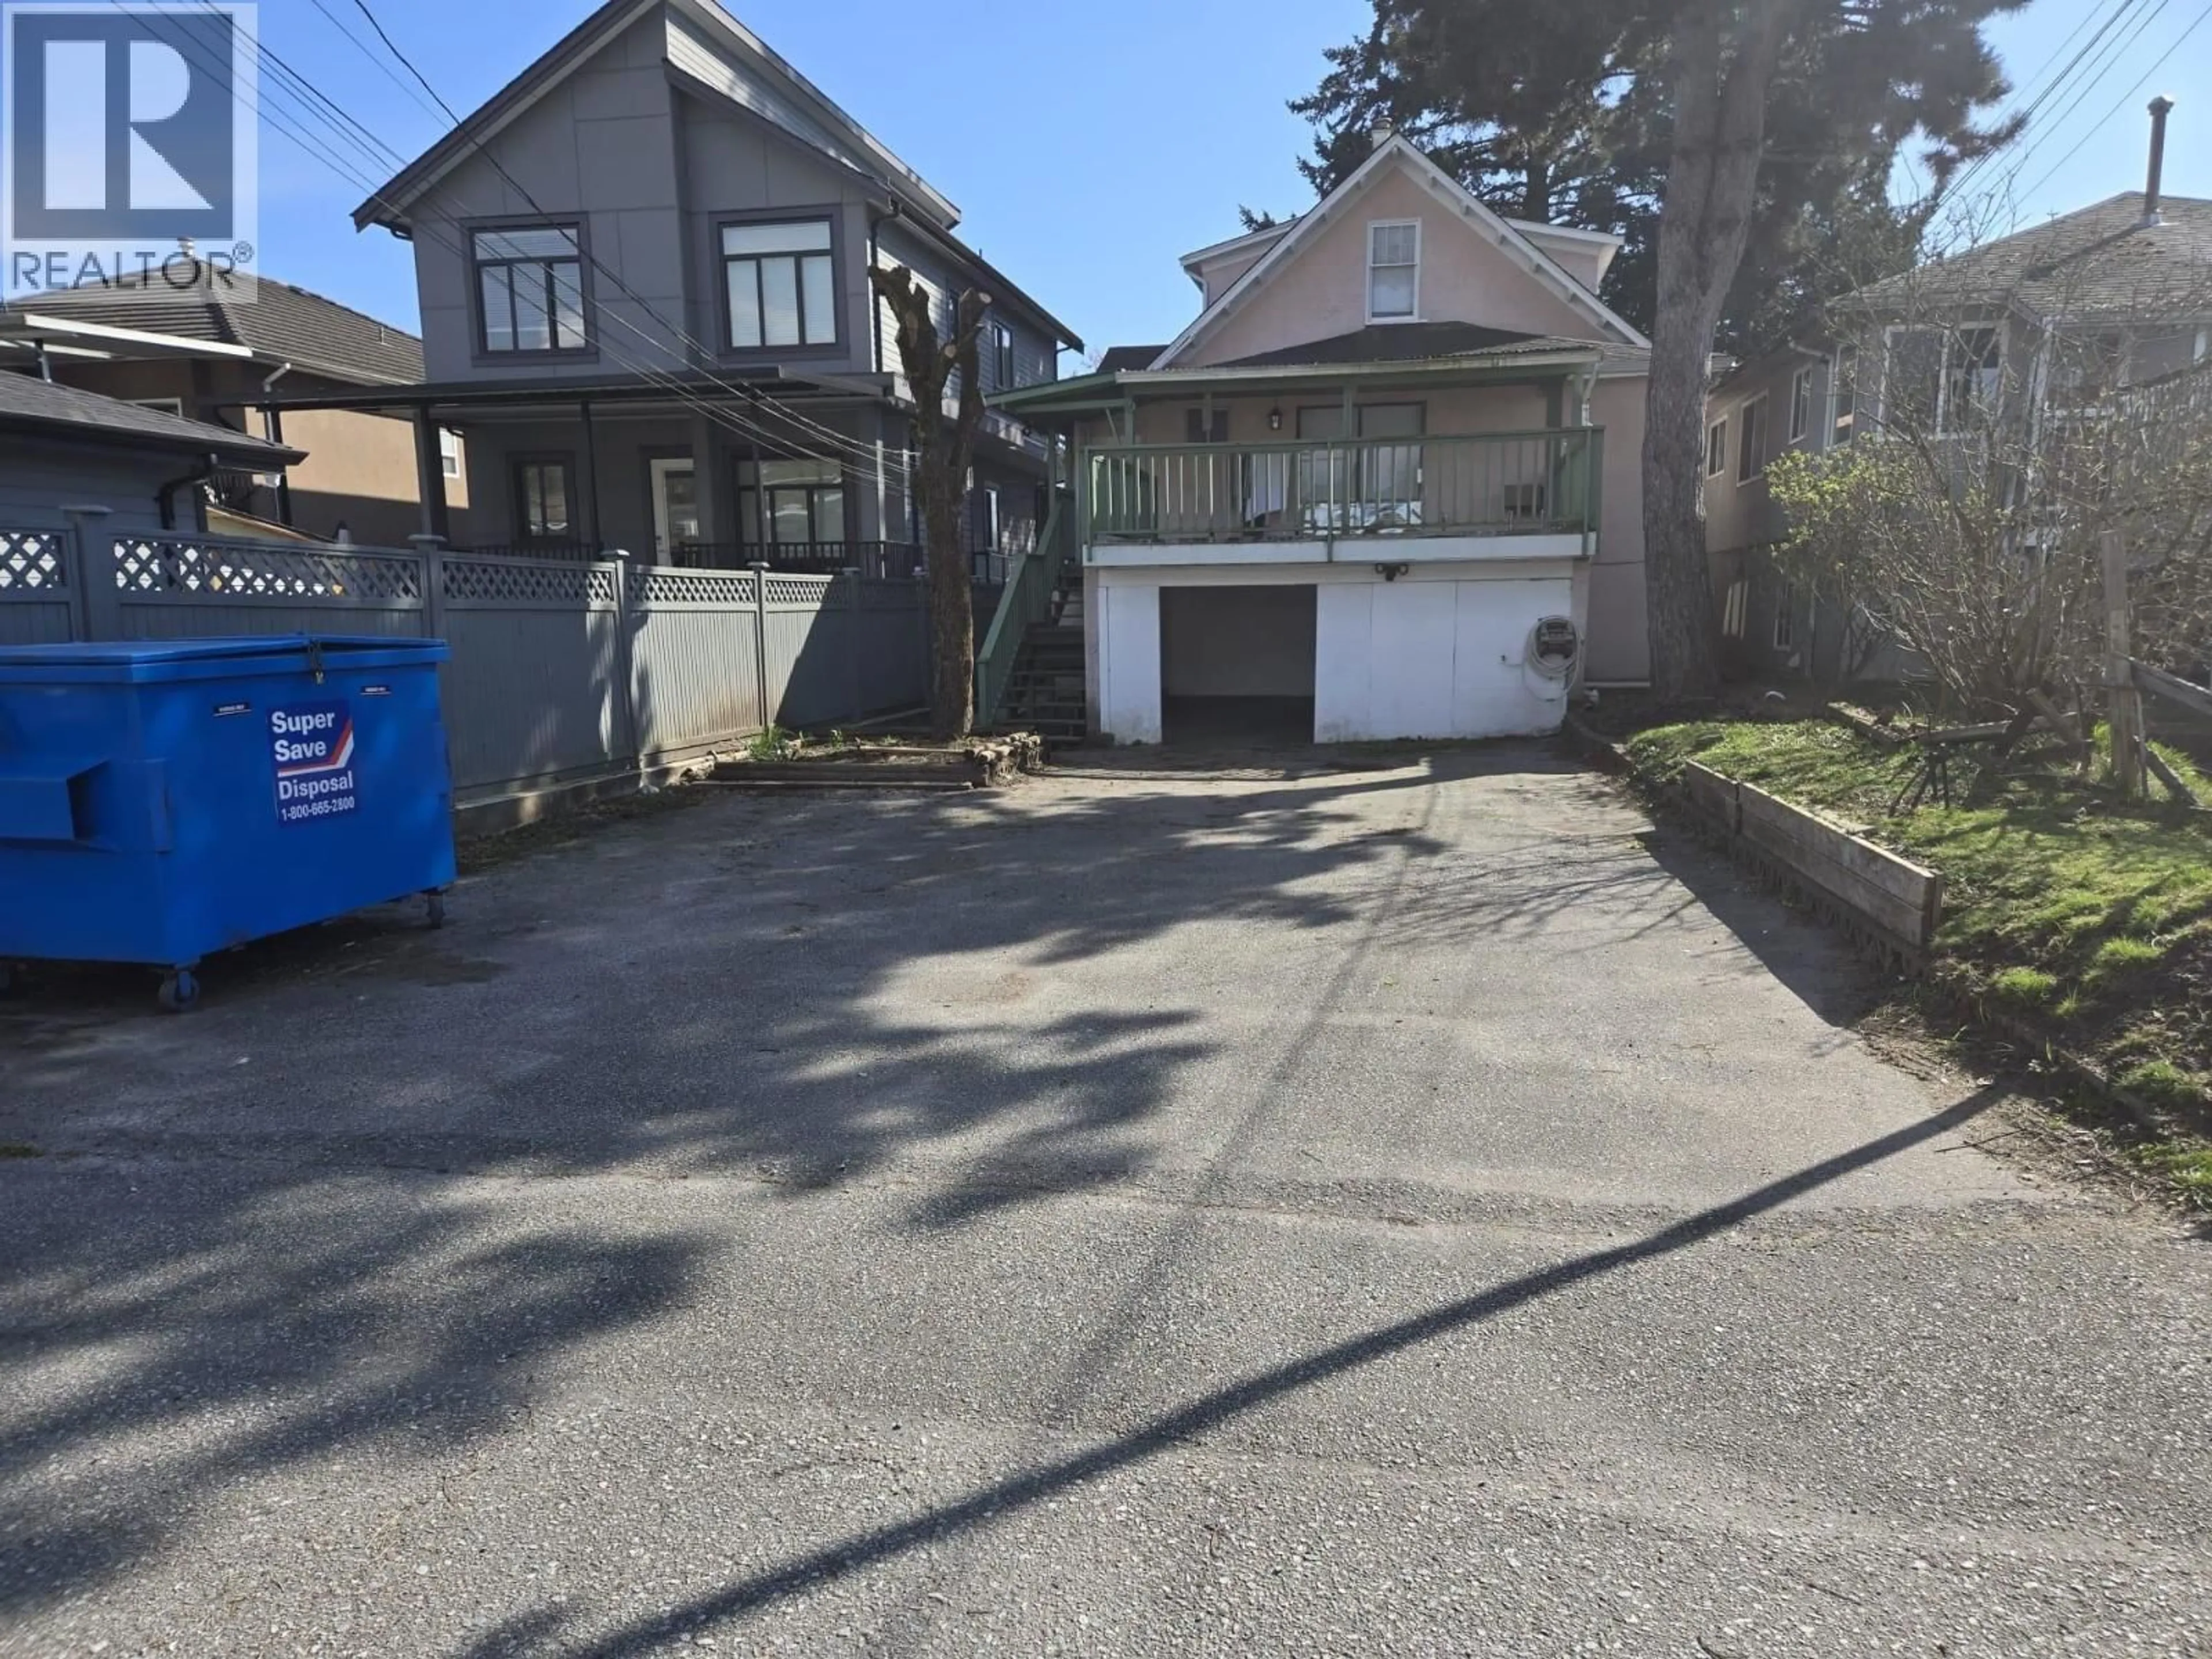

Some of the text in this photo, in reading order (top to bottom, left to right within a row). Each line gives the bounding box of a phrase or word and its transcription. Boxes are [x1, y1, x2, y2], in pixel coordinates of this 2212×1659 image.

[271, 711, 335, 735] Super
[274, 740, 327, 762] Save
[278, 770, 354, 800] Disposal
[281, 796, 355, 821] 1-800-665-2800
